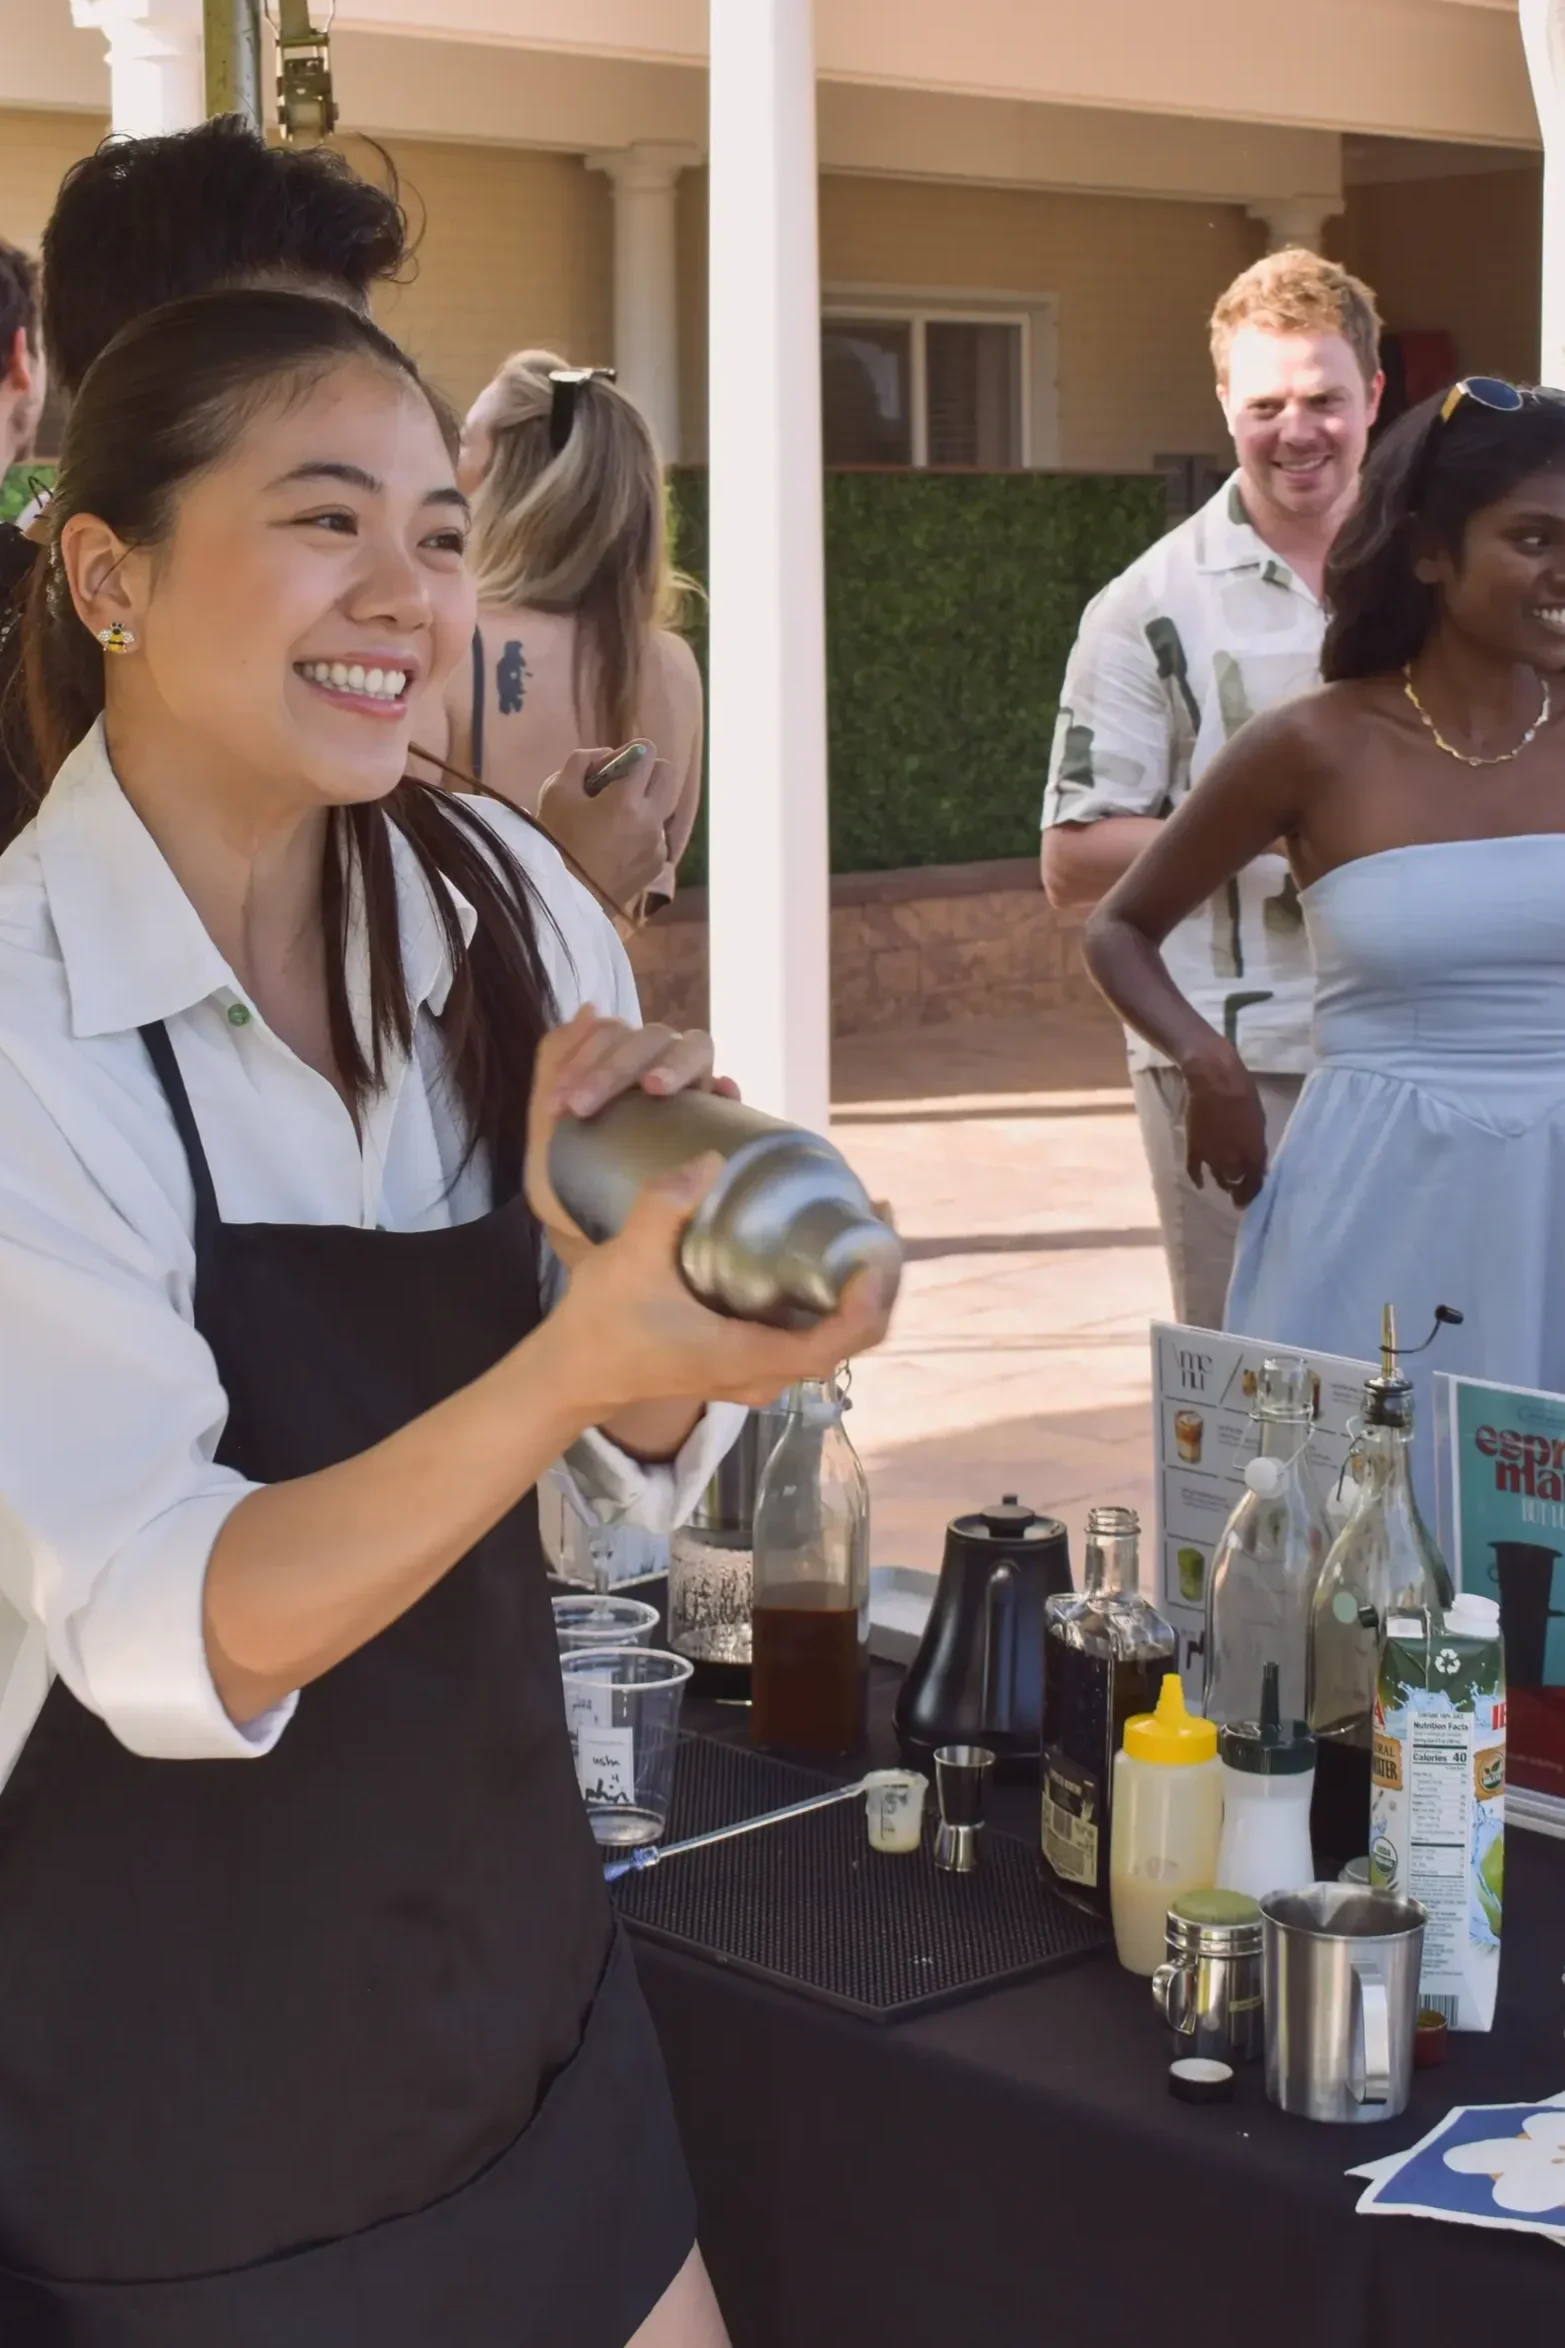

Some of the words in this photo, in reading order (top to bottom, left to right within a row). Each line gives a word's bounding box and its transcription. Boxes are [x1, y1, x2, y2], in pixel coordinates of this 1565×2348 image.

[1495, 1459, 1565, 1503] ma
[1413, 1720, 1447, 1731] Nutrition
[1448, 1721, 1469, 1732] Facts
[1412, 1752, 1448, 1763] Calories
[1452, 1751, 1468, 1763] 40
